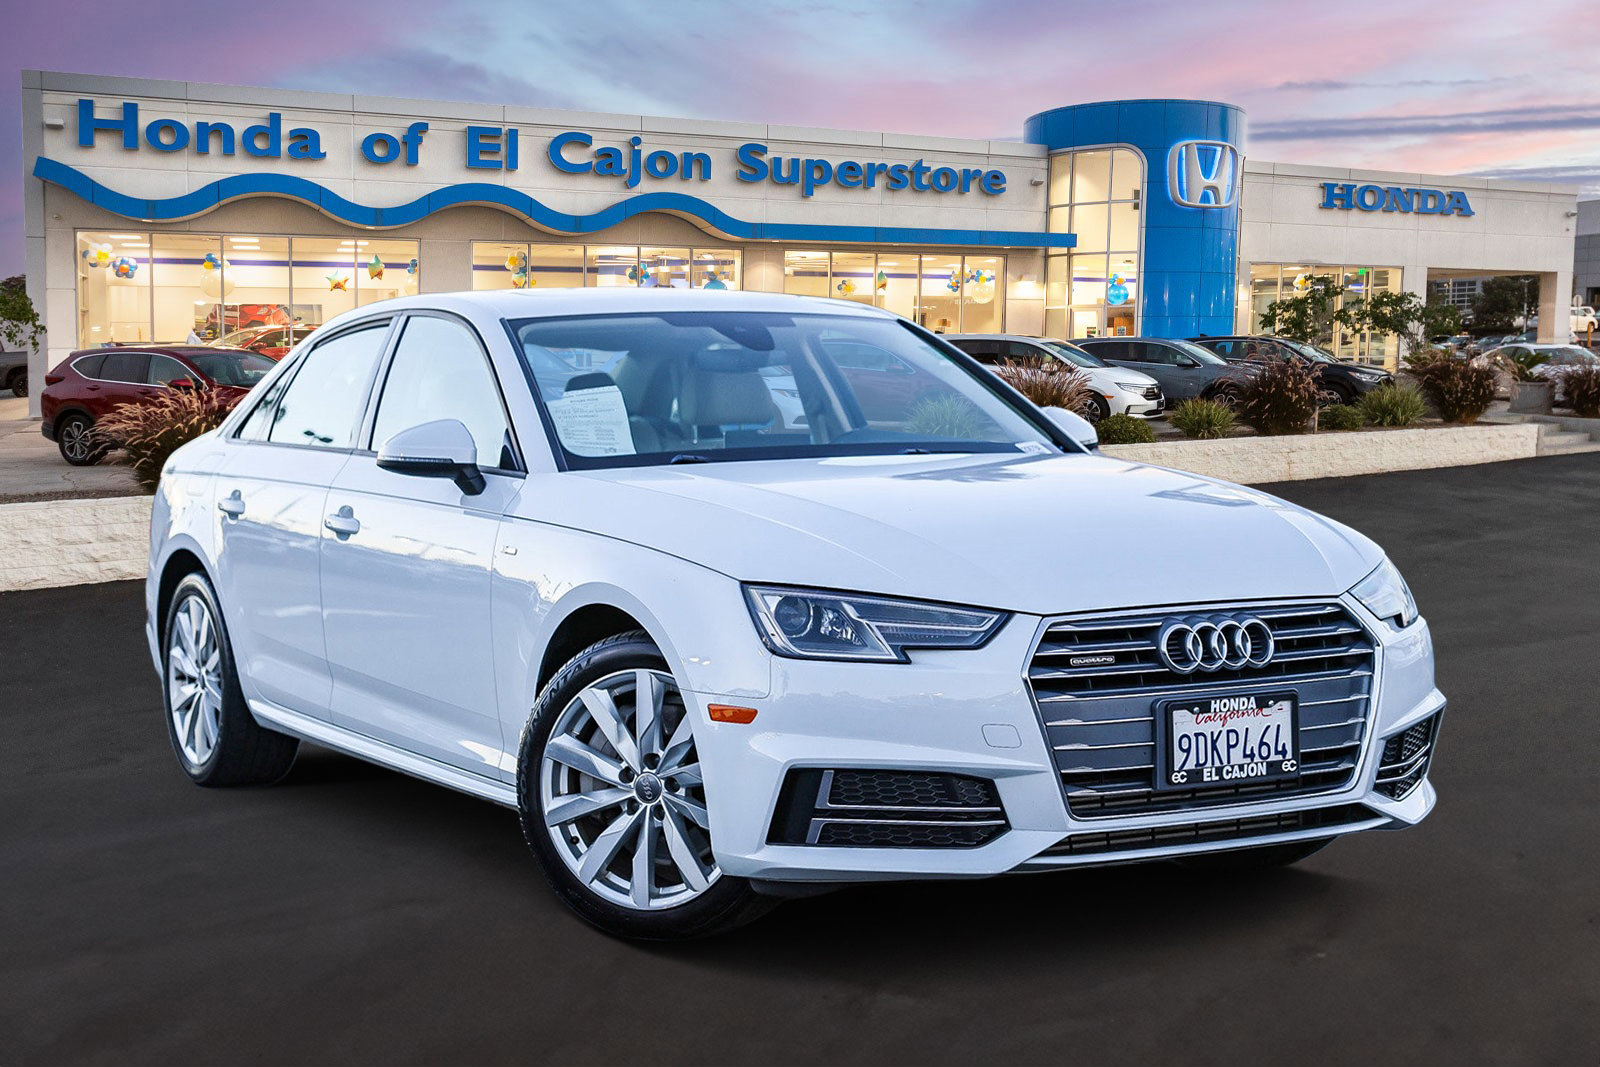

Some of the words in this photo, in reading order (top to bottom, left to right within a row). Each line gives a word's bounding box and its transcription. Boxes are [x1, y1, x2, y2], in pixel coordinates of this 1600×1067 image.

[78, 98, 326, 161] Honda
[361, 122, 429, 166] of
[466, 126, 519, 171] El
[547, 131, 712, 189] Cajon
[736, 142, 1008, 198] Superstore
[1319, 181, 1476, 217] HONDA
[1072, 657, 1114, 665] quattro
[1210, 696, 1257, 713] HONDA
[1195, 707, 1272, 727] California
[1178, 723, 1288, 770] 9DKP464
[1203, 768, 1220, 782] EL
[1222, 761, 1267, 780] CAJON
